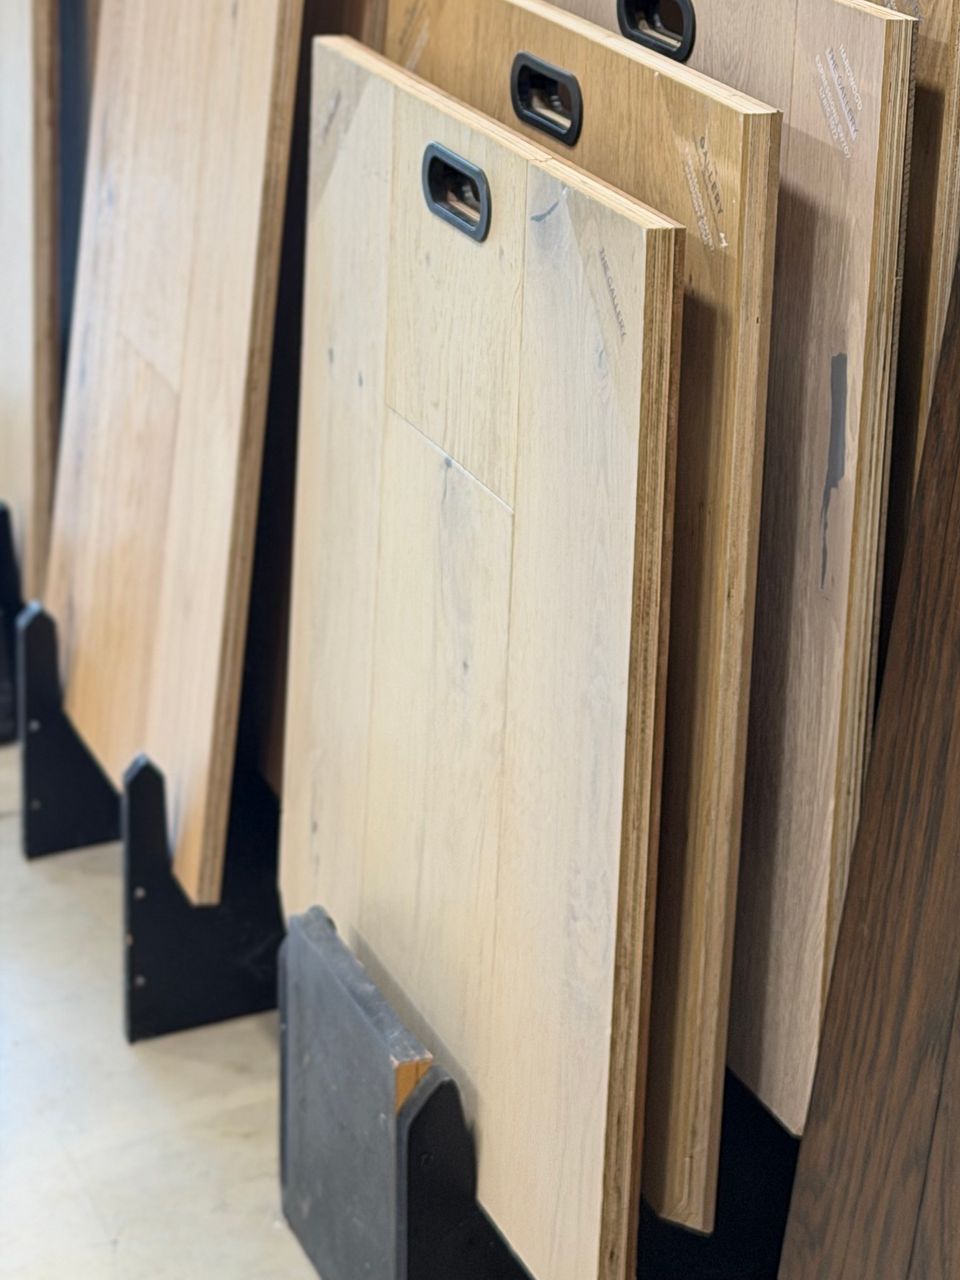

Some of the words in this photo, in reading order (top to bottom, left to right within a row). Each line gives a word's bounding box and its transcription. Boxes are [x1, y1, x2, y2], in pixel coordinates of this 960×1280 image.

[836, 76, 858, 134] GALLERY
[839, 43, 862, 111] HARDWOOD
[699, 135, 723, 214] GALLERY
[605, 275, 627, 337] GALLERY
